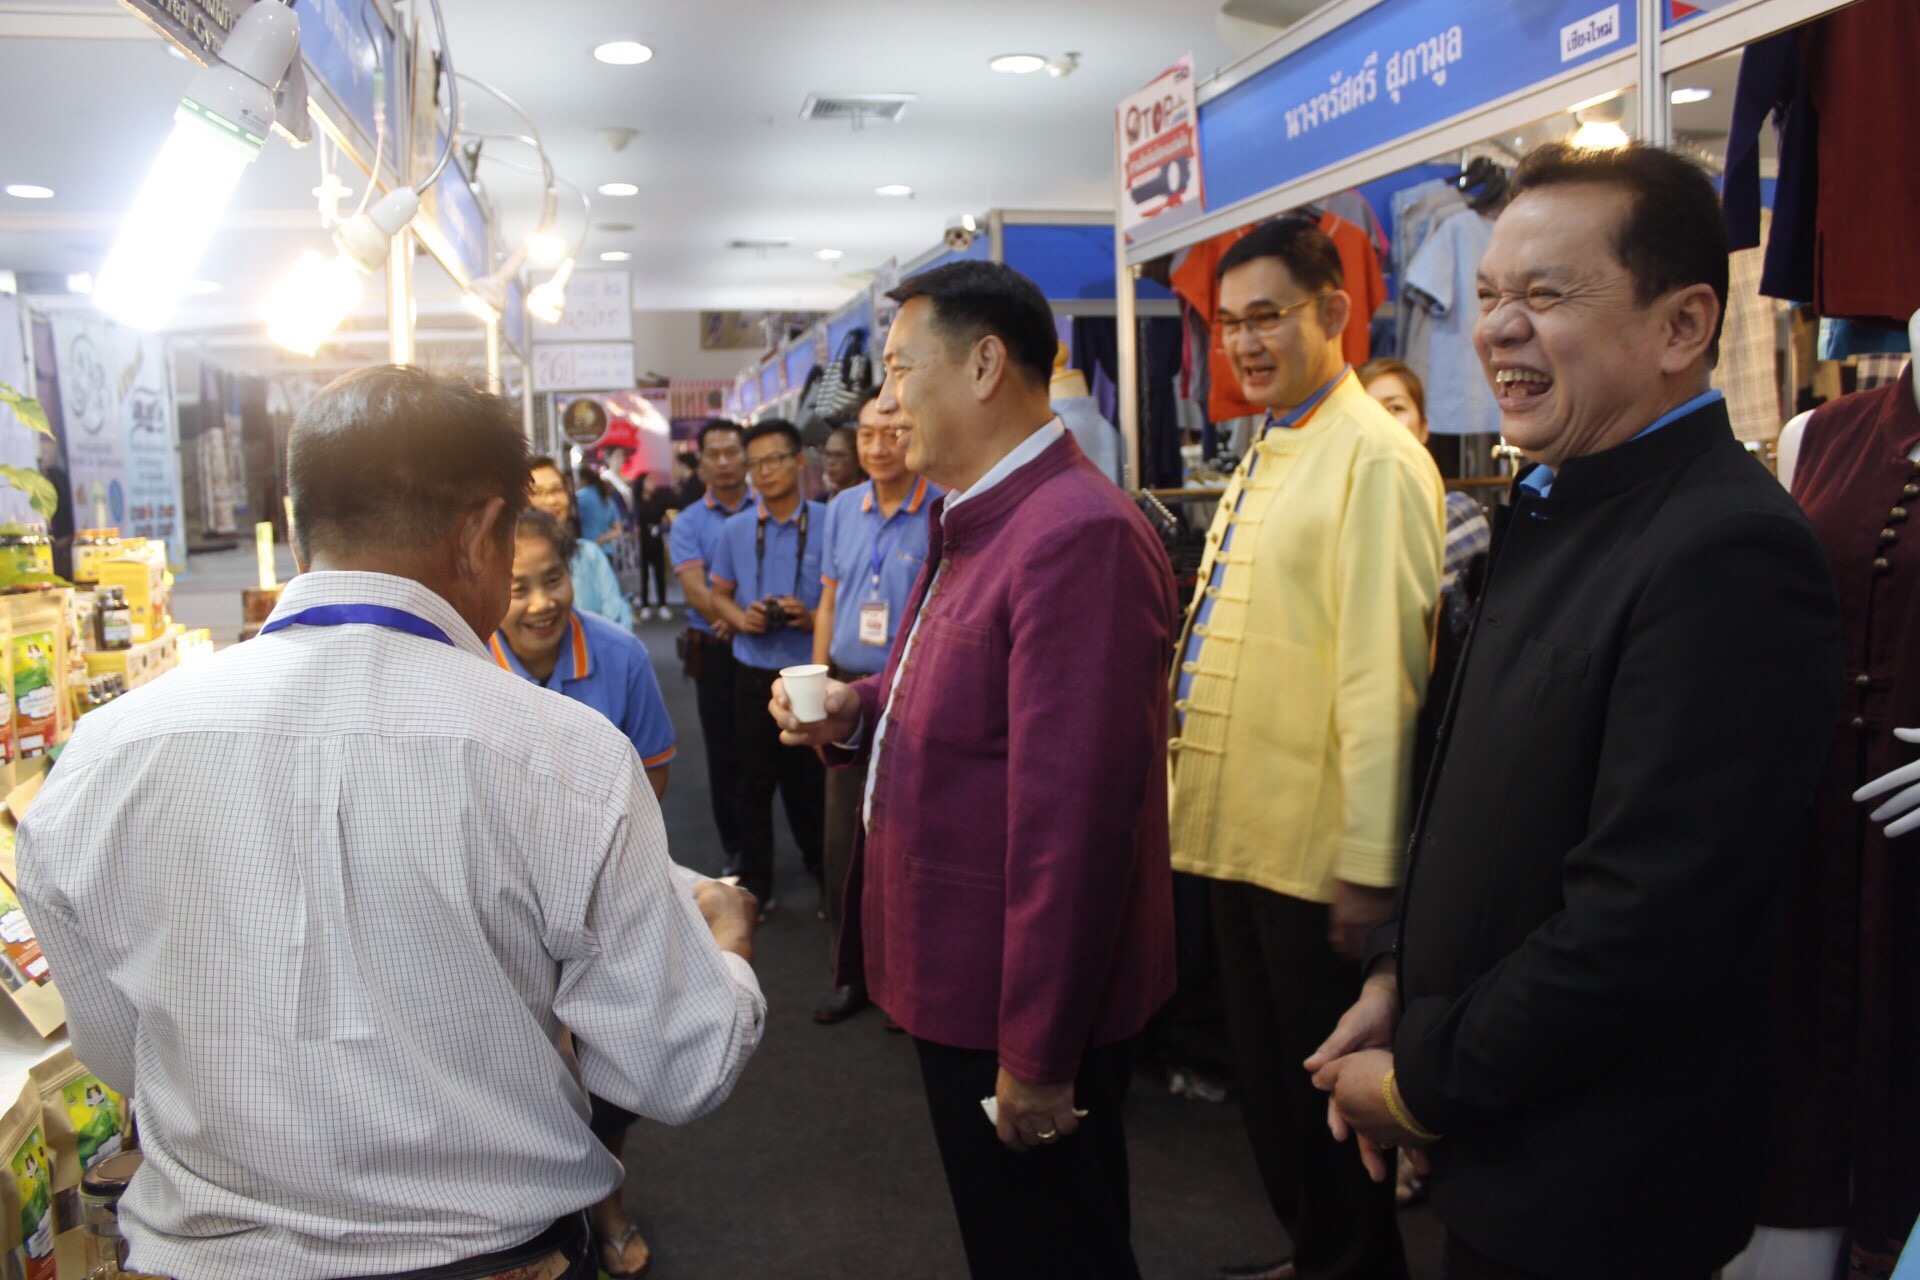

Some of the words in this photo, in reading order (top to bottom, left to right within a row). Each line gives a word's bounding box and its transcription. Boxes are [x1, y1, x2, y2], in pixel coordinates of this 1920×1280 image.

[1566, 15, 1613, 52] เชียงใหม่
[1284, 50, 1379, 139] นางจรัสศรี
[1385, 25, 1463, 104] สุภามูล
